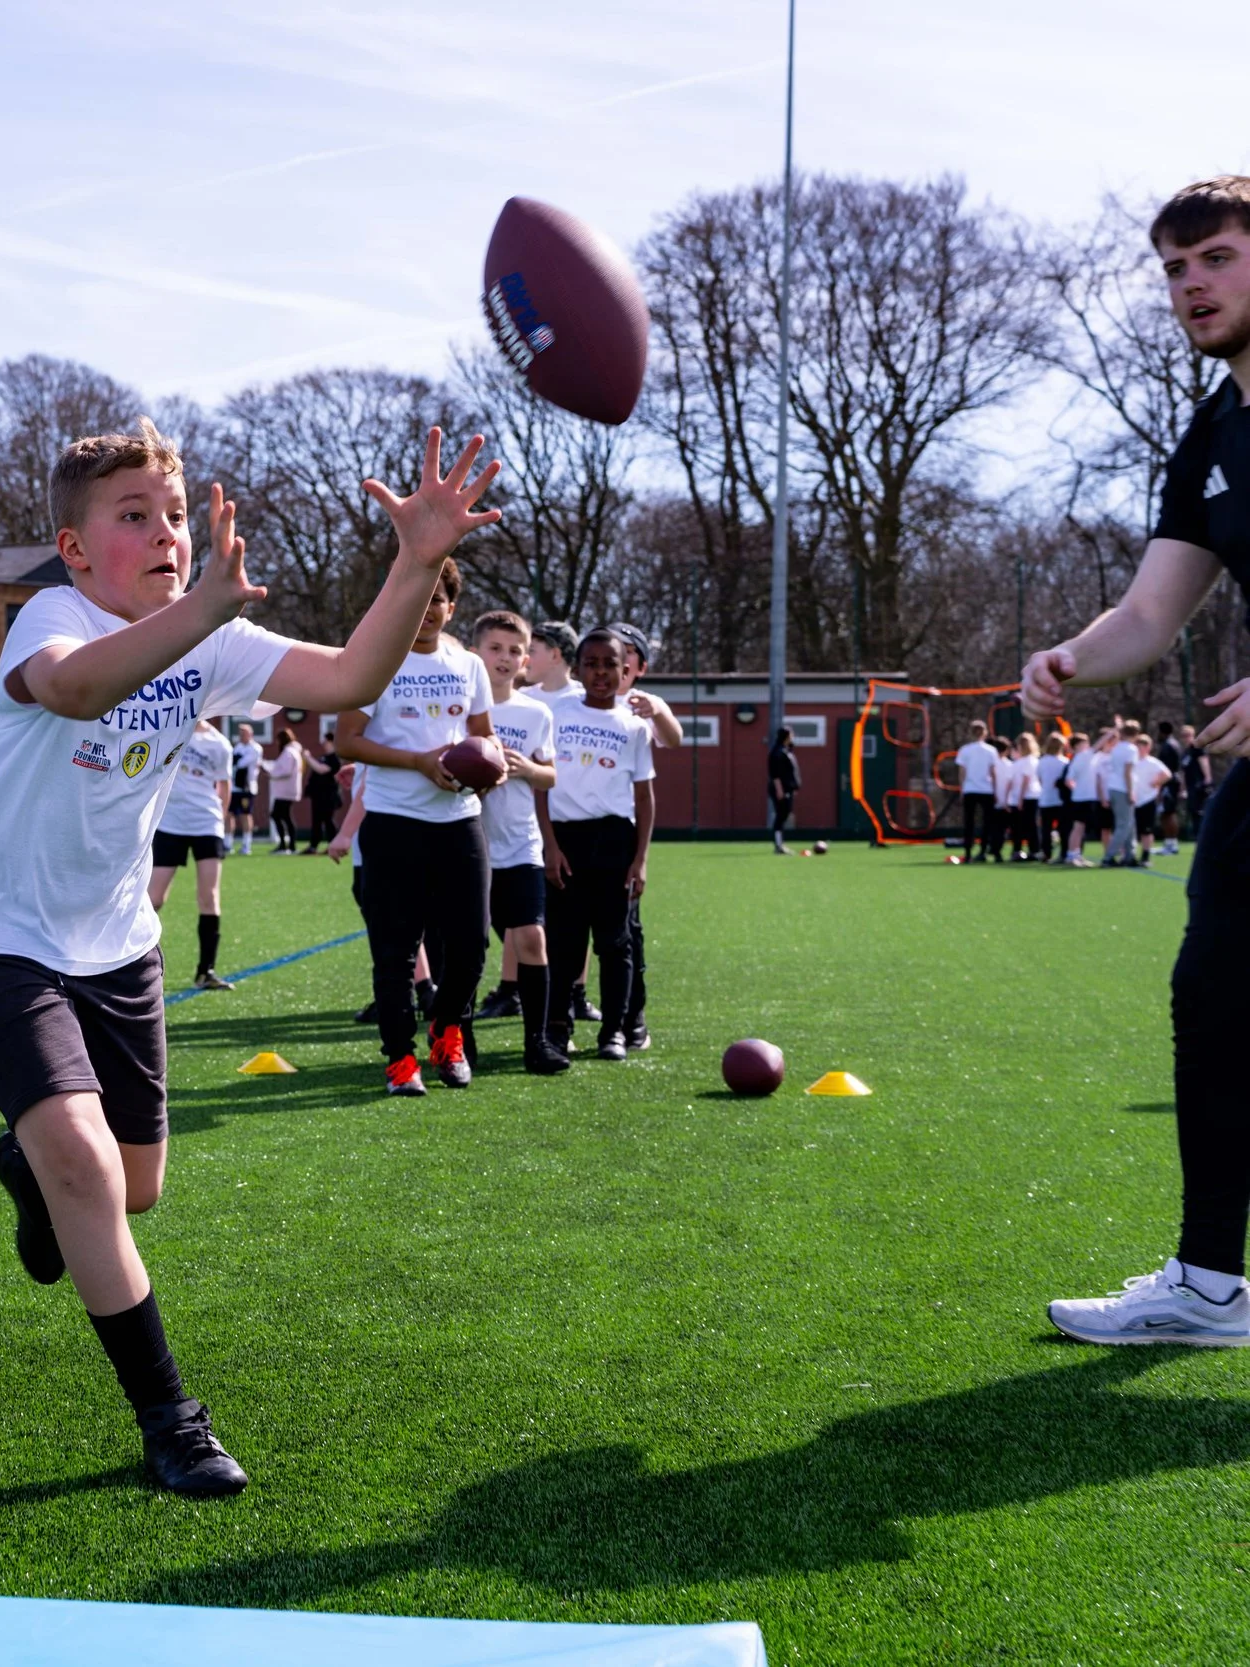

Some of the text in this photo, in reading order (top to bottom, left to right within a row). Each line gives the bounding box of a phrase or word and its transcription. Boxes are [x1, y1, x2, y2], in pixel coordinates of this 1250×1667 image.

[126, 669, 202, 703] CKING
[392, 674, 468, 686] UNLOCKING
[393, 685, 468, 699] POTENTIAL
[99, 698, 198, 731] OTENTIL
[559, 724, 629, 744] UNLOCKING
[91, 742, 107, 757] NFL
[557, 734, 623, 756] POTENTIAL
[74, 749, 111, 767] FOUNDATION
